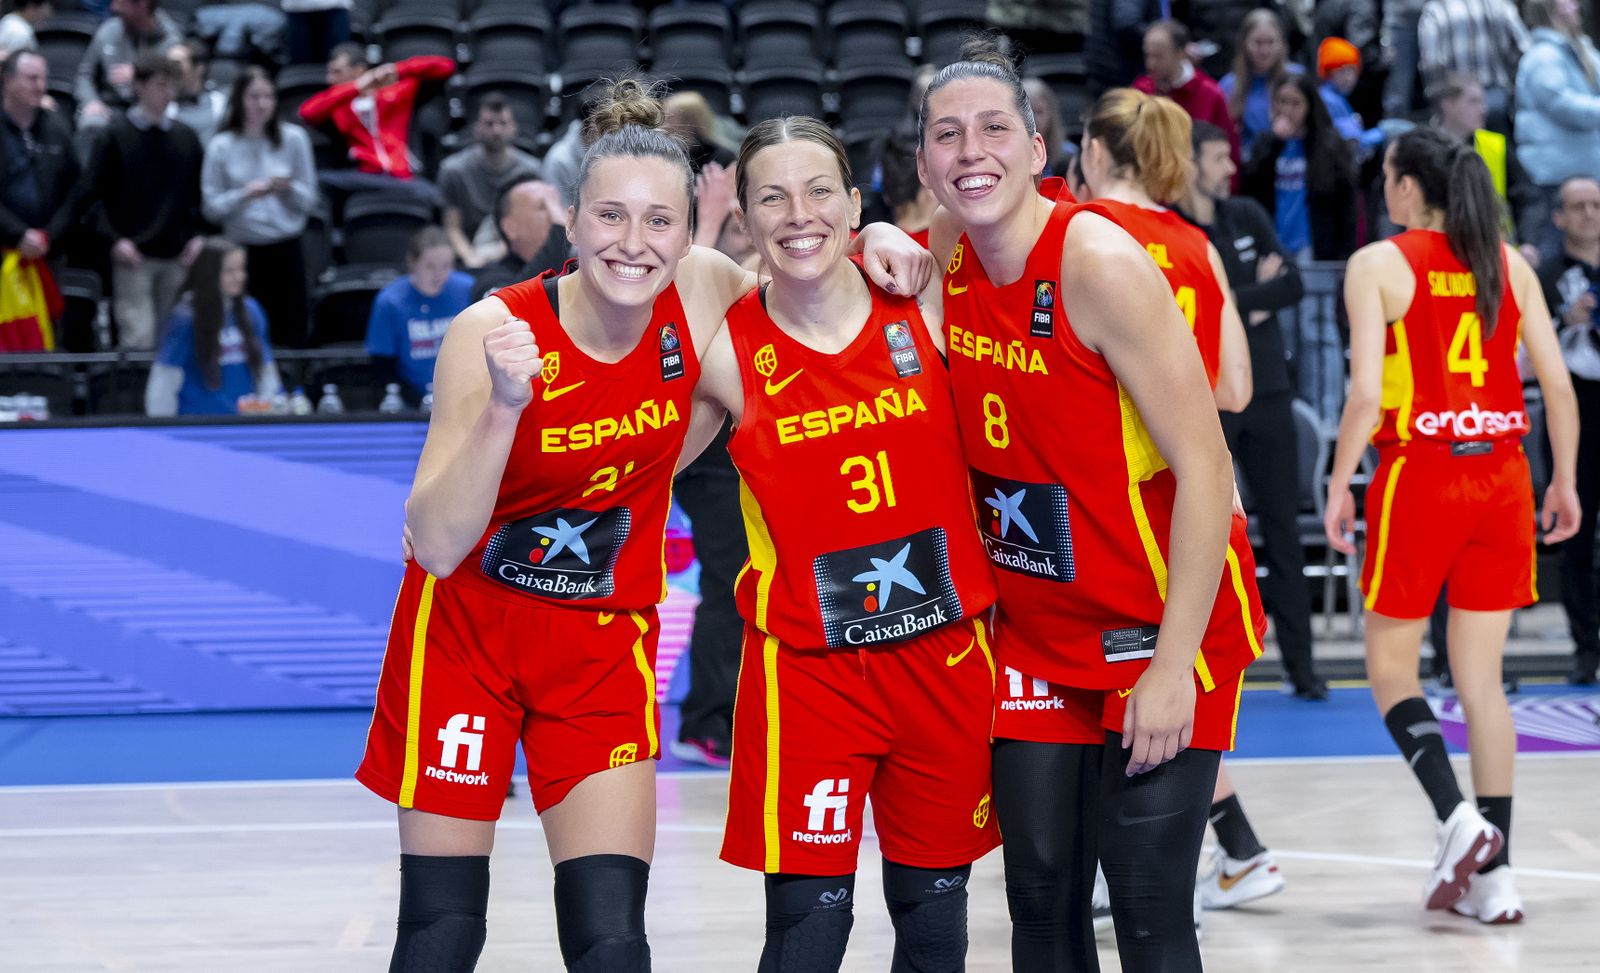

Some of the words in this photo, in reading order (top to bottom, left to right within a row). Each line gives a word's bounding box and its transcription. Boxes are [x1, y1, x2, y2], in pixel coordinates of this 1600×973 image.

[1034, 312, 1050, 324] FIBA
[662, 354, 680, 368] FIBA
[895, 351, 915, 365] FIBA
[949, 324, 1049, 375] ESPAÑA
[1447, 312, 1489, 387] 4
[541, 399, 680, 453] ESPAÑA
[776, 387, 927, 445] ESPAÑA
[982, 392, 1010, 449] 8
[840, 450, 897, 514] 31
[984, 538, 1059, 577] CaixaBank
[498, 563, 597, 594] CaixaBank
[844, 604, 948, 645] CaixaBank
[1001, 696, 1065, 711] network
[437, 713, 486, 771] fi
[425, 765, 489, 786] network
[803, 778, 850, 831] fi
[792, 828, 852, 844] network
